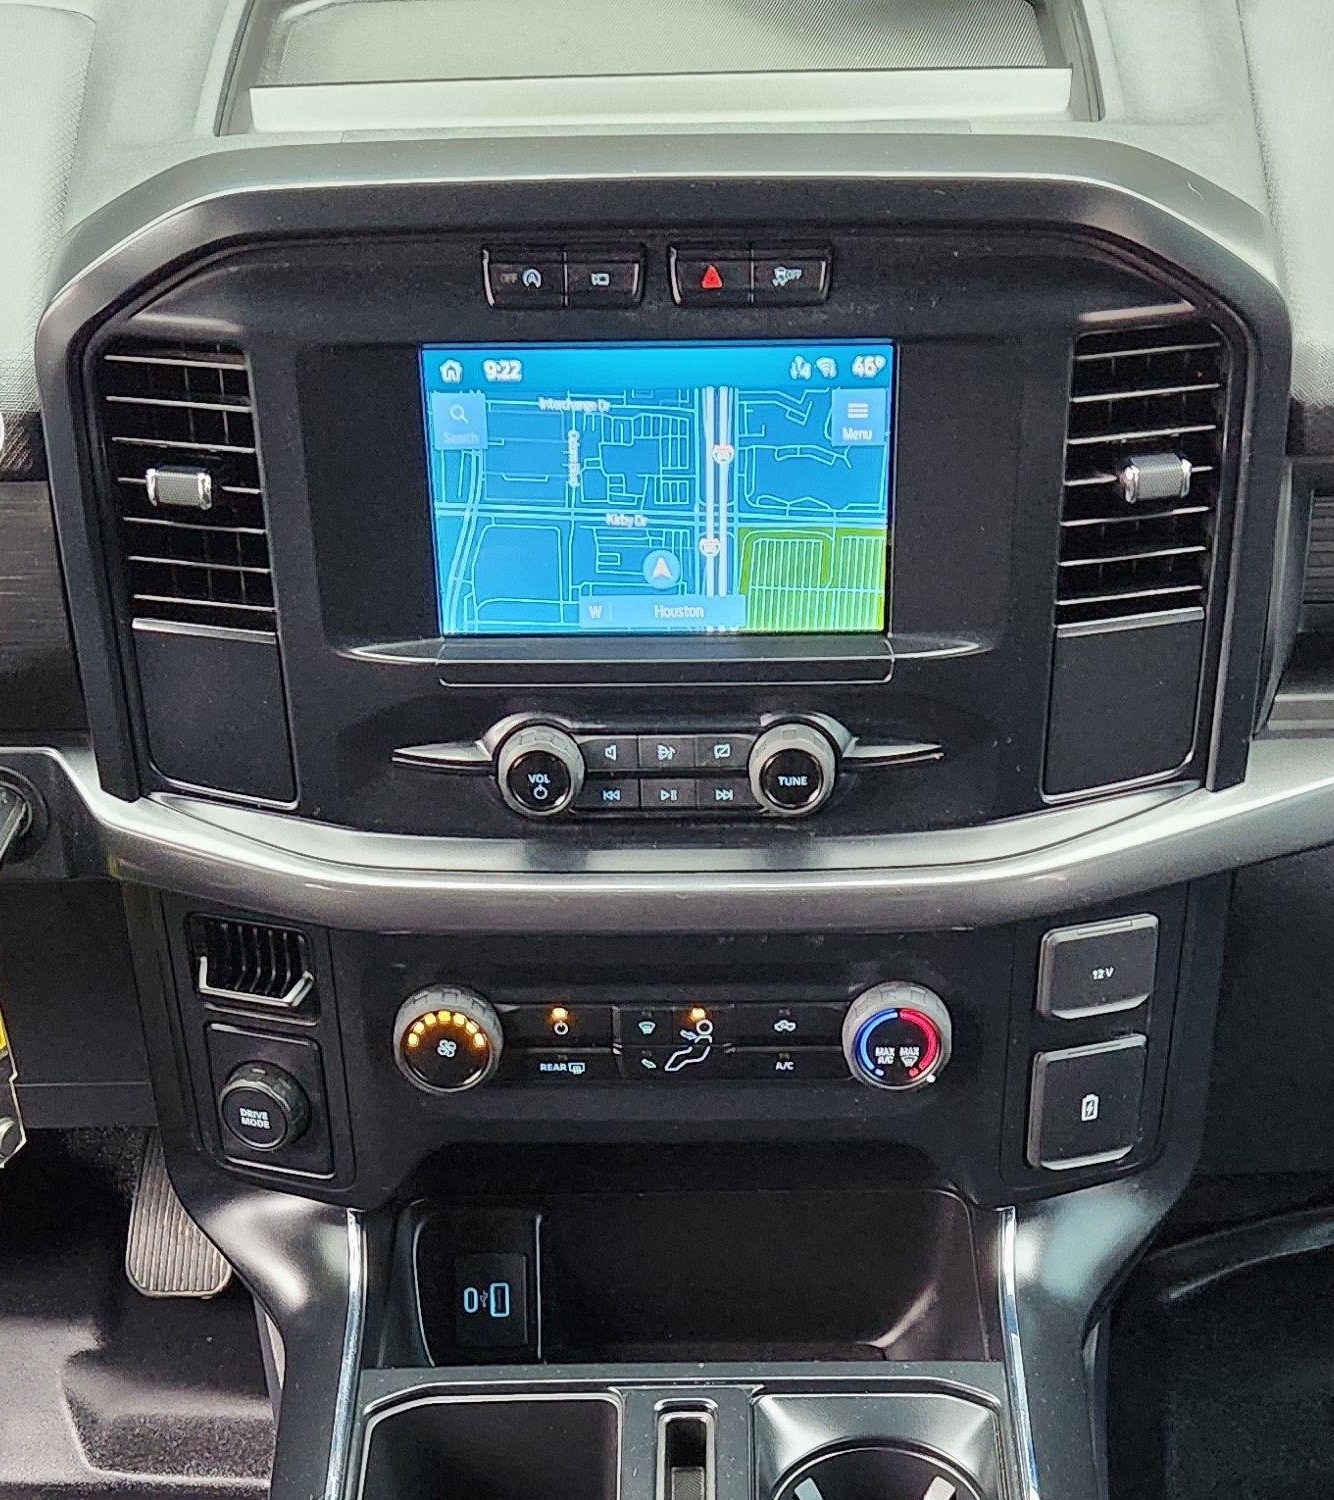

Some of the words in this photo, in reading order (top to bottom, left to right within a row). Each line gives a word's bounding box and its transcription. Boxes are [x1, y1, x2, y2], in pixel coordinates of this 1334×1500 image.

[482, 358, 523, 382] 9:22
[842, 427, 873, 441] Menu
[588, 604, 603, 619] W
[653, 604, 705, 619] Houston
[527, 773, 551, 784] VOL
[777, 775, 808, 787] TUNE
[875, 1046, 896, 1057] MAX
[899, 1046, 920, 1057] MAX
[539, 1062, 568, 1072] REAR
[775, 1061, 795, 1071] A/C
[239, 1107, 269, 1120] DRIVE
[240, 1117, 271, 1130] MODE
